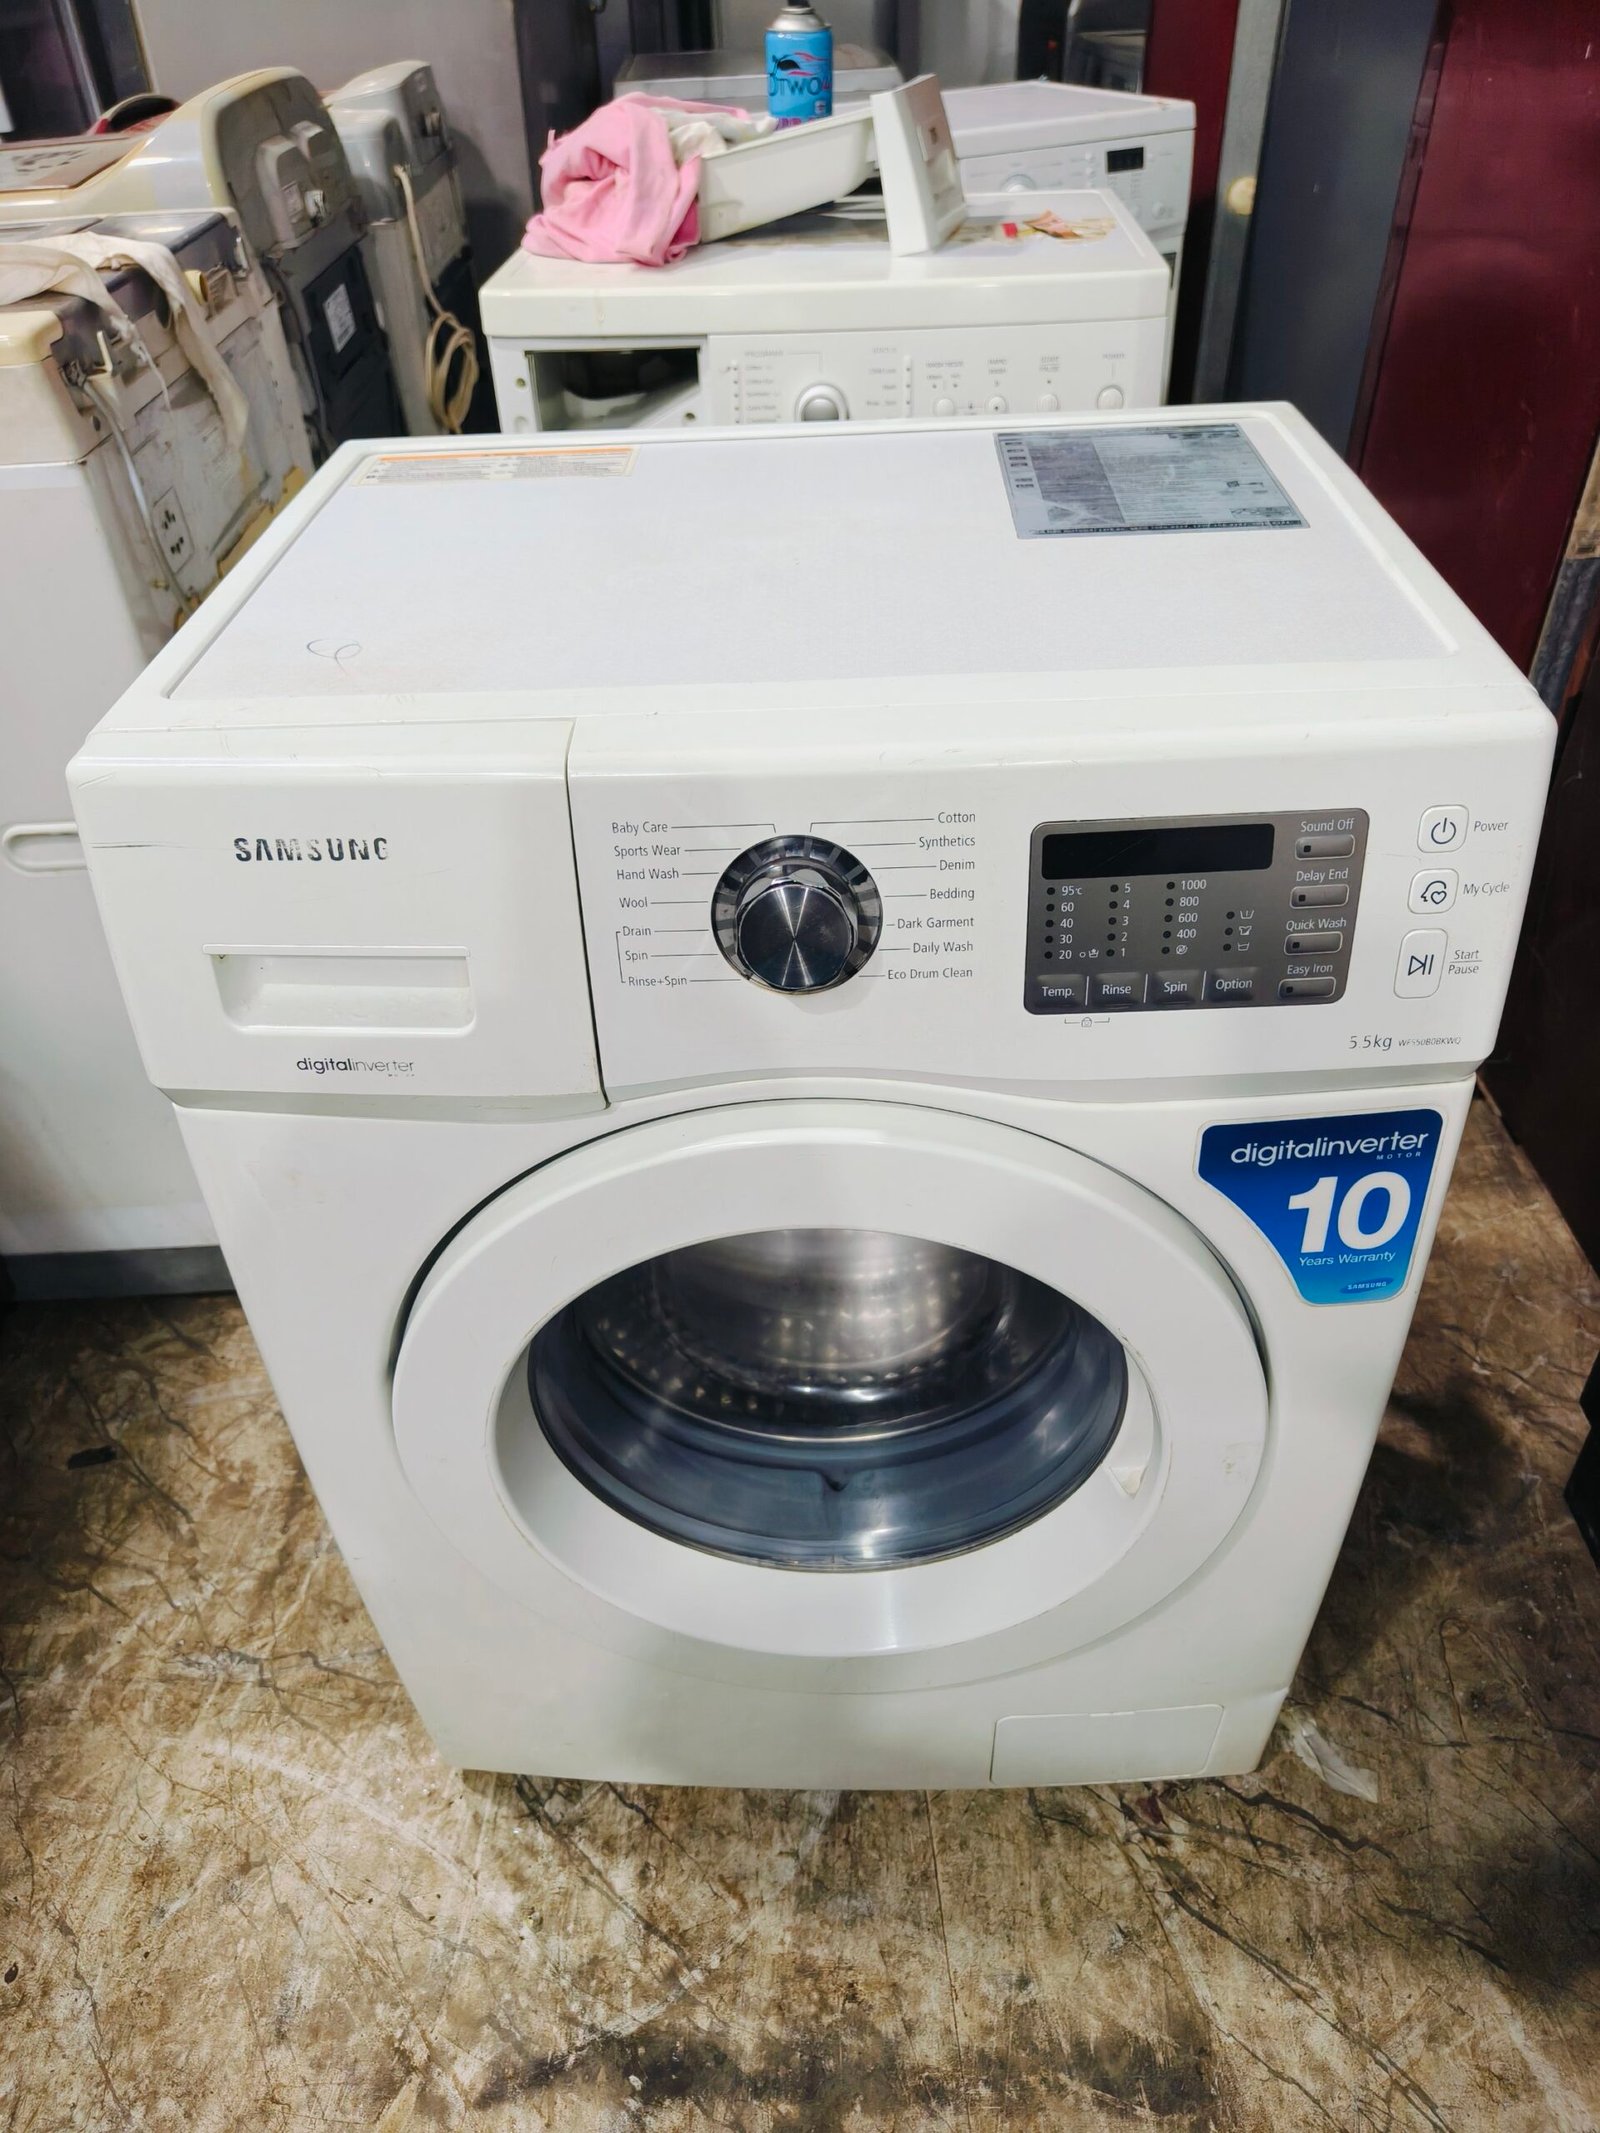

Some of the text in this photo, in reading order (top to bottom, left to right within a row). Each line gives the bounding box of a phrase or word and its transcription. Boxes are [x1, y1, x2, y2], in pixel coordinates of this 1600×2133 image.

[937, 812, 976, 824] Cotton
[612, 821, 668, 836] Baby Care
[1300, 818, 1355, 833] Sound Off
[1474, 820, 1509, 832] Power
[918, 836, 976, 849] Synthetics
[234, 837, 389, 862] SAMSUNG
[614, 845, 681, 859] Sports Wear
[939, 859, 975, 871] Denim
[616, 867, 680, 880] Hand Wash
[1296, 868, 1349, 883] Delay End
[1124, 883, 1131, 893] 5
[1180, 879, 1207, 890] 1000
[1463, 882, 1510, 896] My Cycle
[930, 888, 975, 901] Bedding
[1179, 896, 1199, 906] 800
[619, 897, 648, 909] Wool
[1061, 902, 1074, 912] 60
[1123, 900, 1130, 909] 4
[897, 916, 974, 929] Dark Garment
[1060, 918, 1074, 928] 40
[1122, 916, 1129, 926] 3
[1178, 913, 1198, 923] 600
[622, 925, 651, 937] Drain
[1286, 918, 1346, 932] Quick Wash
[1059, 934, 1073, 944] 30
[1121, 932, 1128, 942] 2
[1177, 929, 1197, 939] 400
[913, 941, 974, 955] Daily Wash
[1453, 949, 1479, 960] Start
[625, 950, 648, 963] Spin
[1059, 950, 1072, 960] 20
[887, 966, 973, 980] Eco Drum Clean
[1287, 963, 1333, 976] Easy Iron
[1448, 964, 1479, 975] Pause
[628, 974, 688, 988] Rinse+Spin
[1164, 981, 1188, 994] Spin
[1216, 978, 1253, 992] Option
[1042, 985, 1075, 999] Temp.
[1102, 984, 1132, 994] Rinse
[1349, 1034, 1392, 1051] 5.5kg
[296, 1057, 414, 1075] digitalinverter
[1230, 1131, 1429, 1167] digitalinverter
[1376, 1151, 1422, 1161] MOTOR
[1288, 1171, 1411, 1253] 10
[1299, 1251, 1396, 1267] Years Warranty
[1347, 1281, 1387, 1290] SAMSUNG
